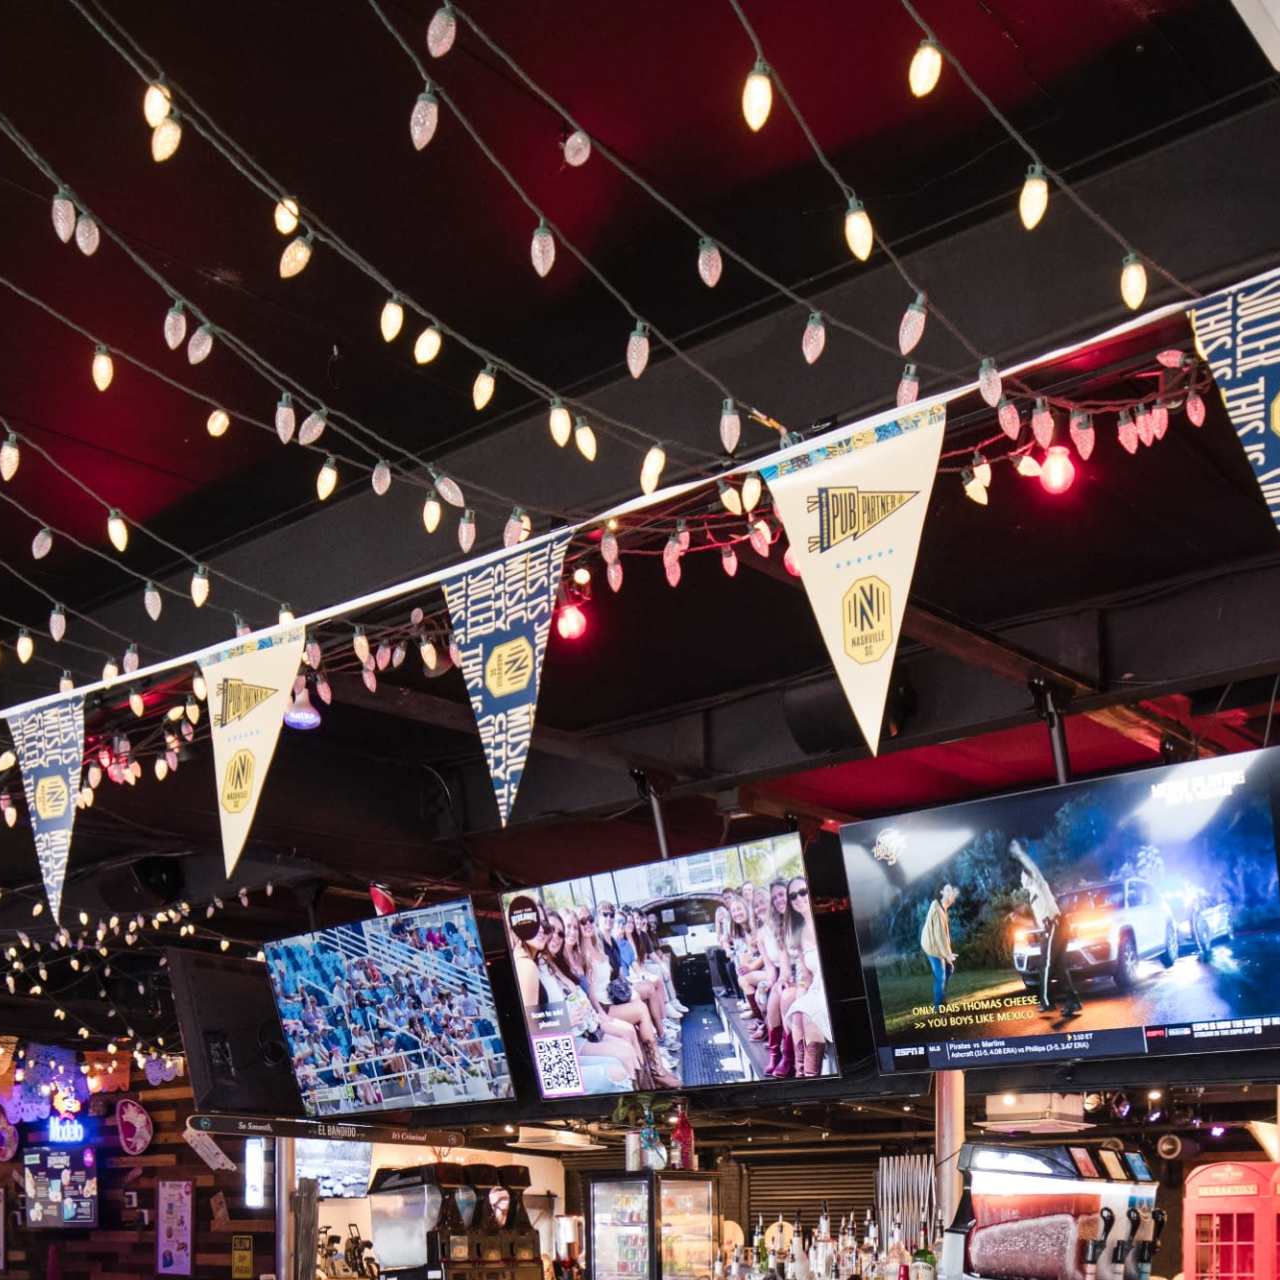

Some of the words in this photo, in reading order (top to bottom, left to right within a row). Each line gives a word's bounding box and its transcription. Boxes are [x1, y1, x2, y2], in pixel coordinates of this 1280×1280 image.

[832, 492, 857, 541] PUB
[862, 494, 896, 530] PARTNER
[505, 552, 527, 631] MUSIC
[527, 543, 551, 595] THIS
[494, 563, 505, 631] CITY
[527, 596, 549, 621] IS
[851, 632, 885, 648] NASHVILLE
[42, 708, 60, 768] MUSIC
[493, 712, 506, 780] CITY
[506, 704, 530, 780] MUSIC
[927, 1018, 948, 1029] YOU
[950, 1014, 974, 1026] BOYS
[975, 1013, 995, 1024] LIKE
[997, 1010, 1034, 1022] MEXICO
[961, 1000, 1002, 1012] THOMAS
[318, 1124, 326, 1136] EL
[327, 1125, 356, 1138] BANDIDO
